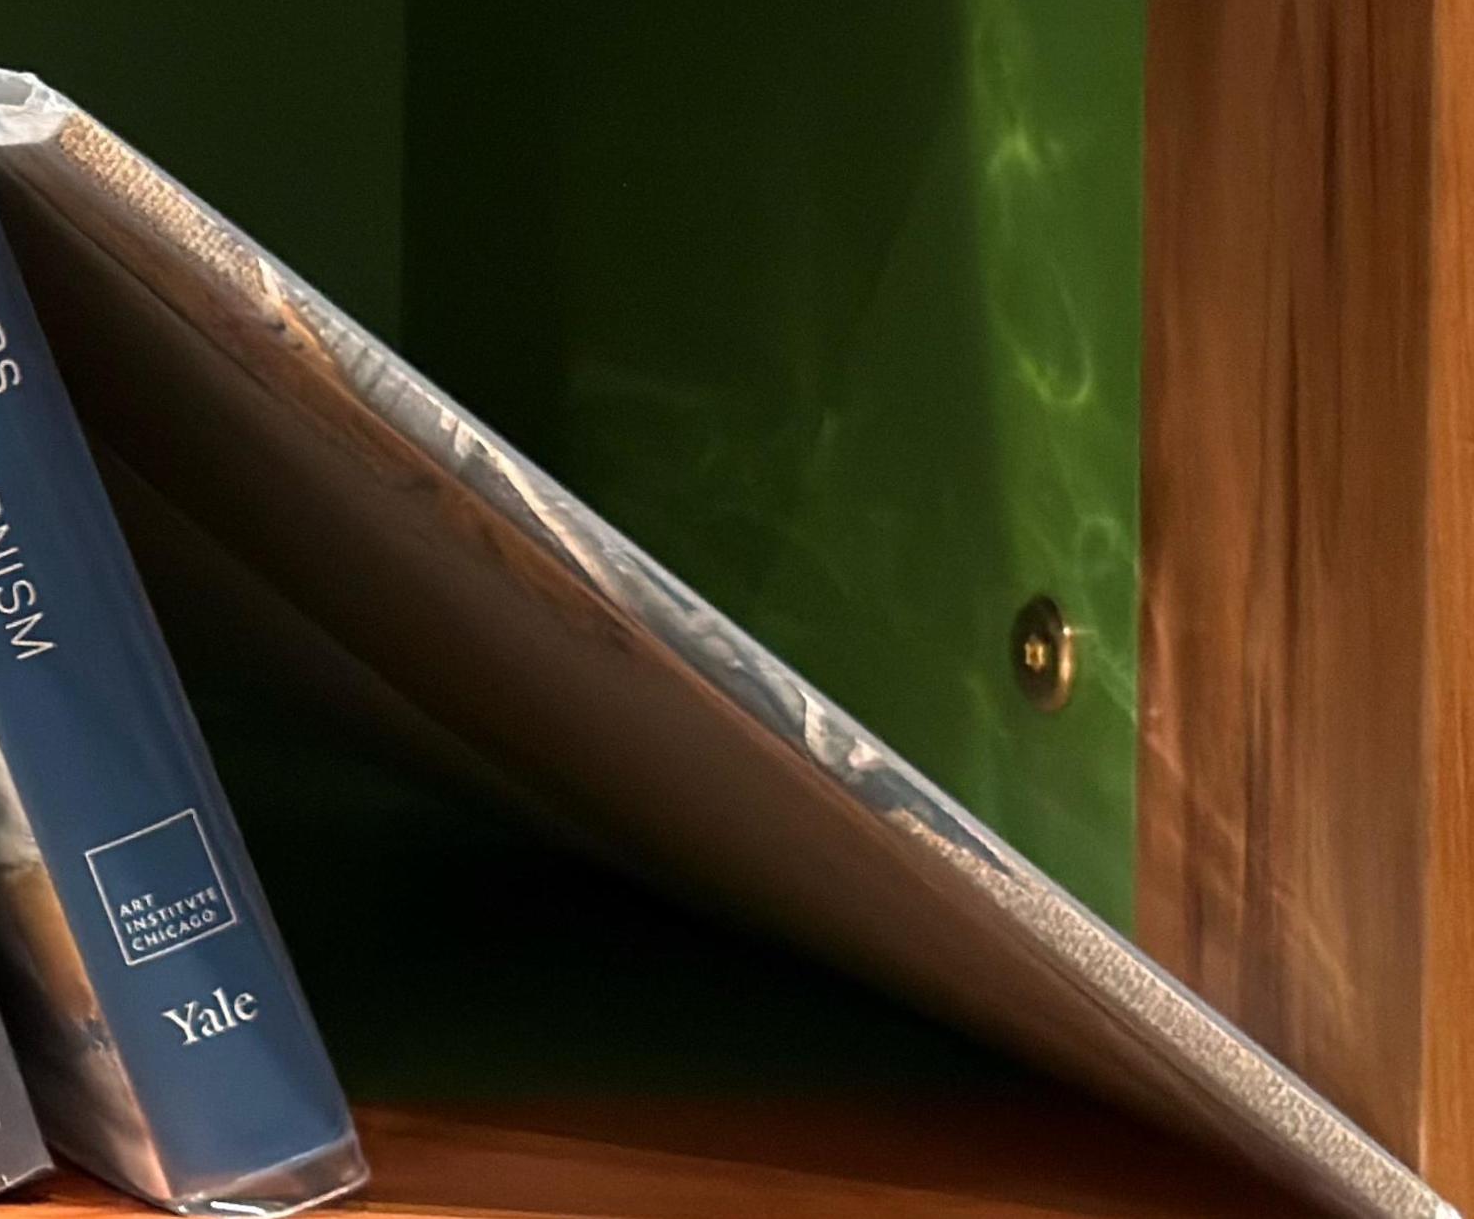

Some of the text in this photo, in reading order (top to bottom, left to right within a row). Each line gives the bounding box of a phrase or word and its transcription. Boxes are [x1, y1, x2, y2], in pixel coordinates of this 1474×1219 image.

[119, 893, 155, 919] ART
[131, 909, 218, 952] CHICAGO
[160, 986, 260, 1046] Yale
